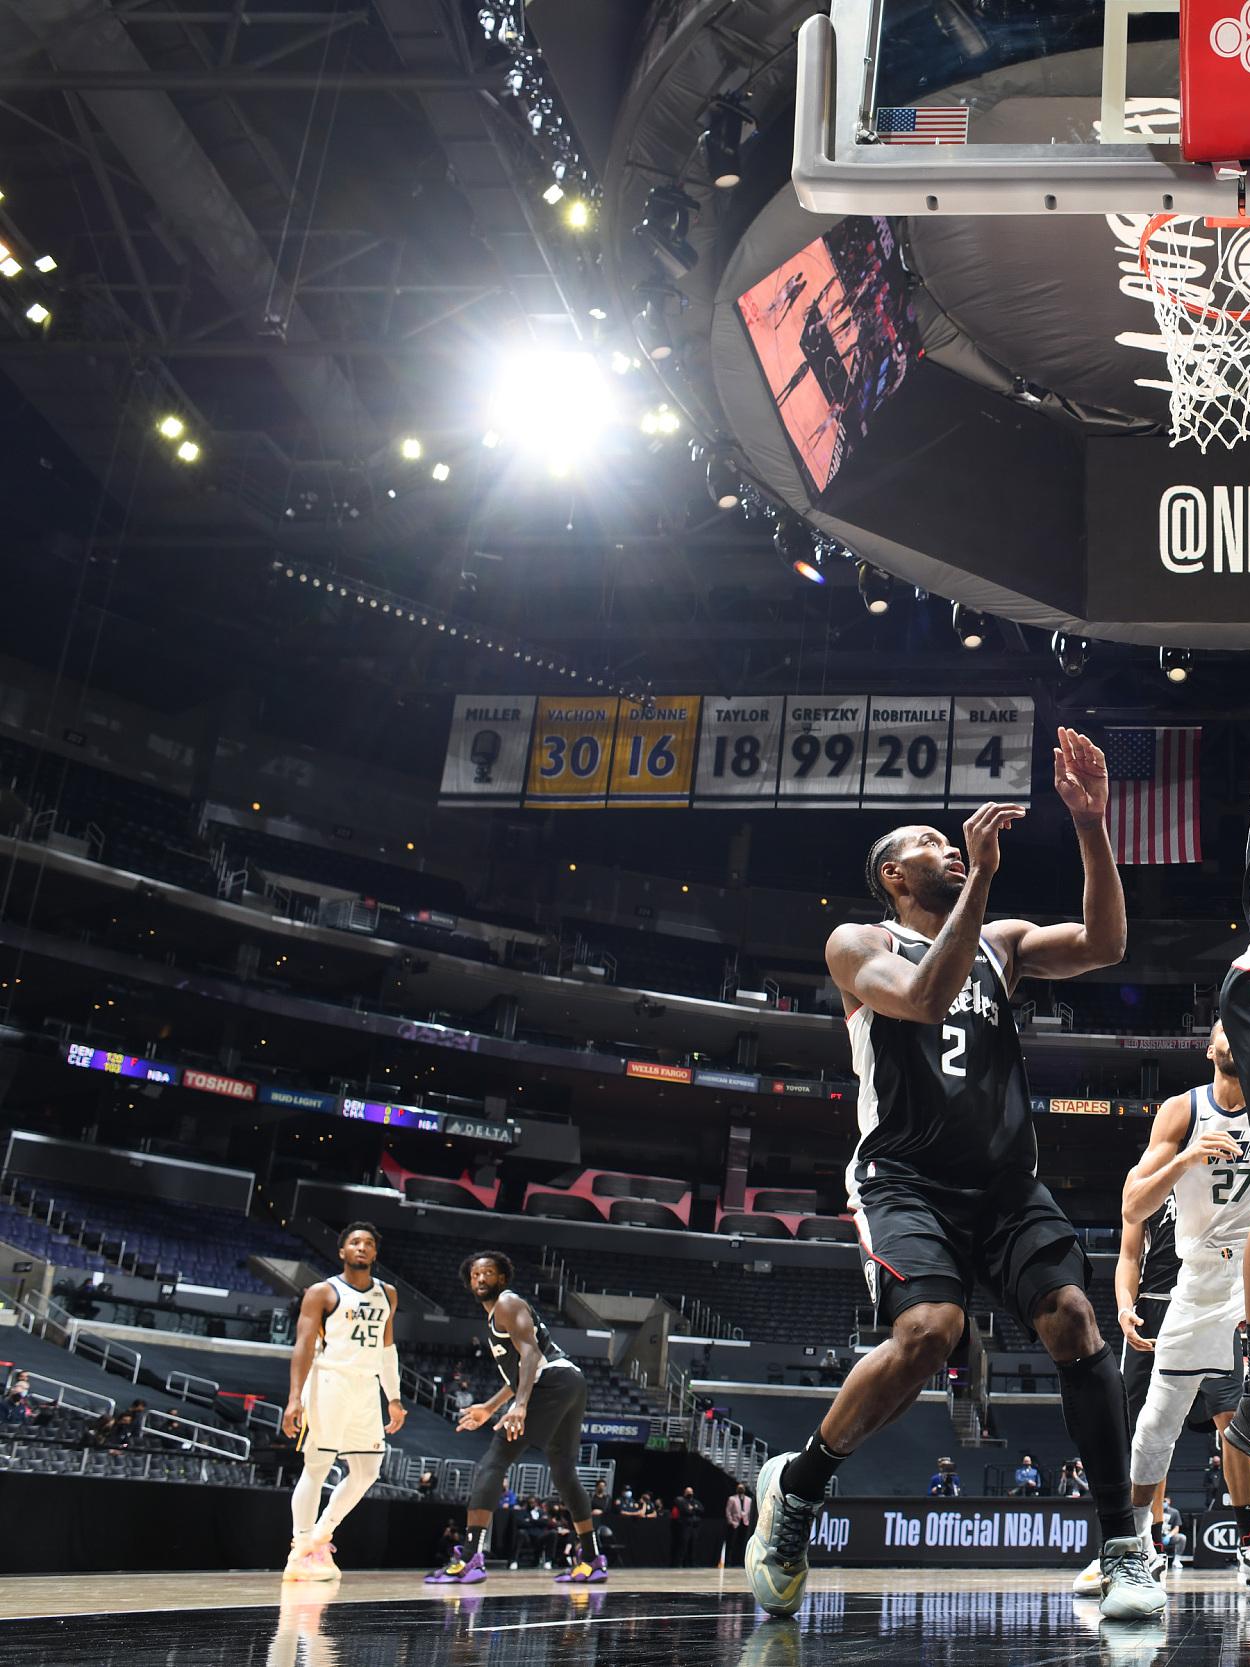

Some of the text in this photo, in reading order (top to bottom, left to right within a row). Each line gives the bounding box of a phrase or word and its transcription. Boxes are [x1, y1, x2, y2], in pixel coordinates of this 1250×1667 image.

[465, 708, 521, 722] MILLER
[547, 710, 607, 722] VACHON
[629, 708, 687, 721] DIONNE
[716, 709, 769, 722] TAYLOR
[792, 708, 859, 722] GRETZKY
[872, 709, 947, 723] ROBITAILLE
[969, 710, 1018, 723] BLAKE
[539, 735, 600, 778] 30
[627, 734, 676, 778] 16
[713, 735, 761, 778] 18
[791, 734, 855, 778] 99
[874, 735, 938, 779] 20
[975, 735, 1004, 779] 4
[69, 1043, 95, 1057] DEN
[942, 1024, 966, 1077] 2
[67, 1054, 91, 1068] CLE
[147, 1069, 170, 1083] NBA
[631, 1064, 688, 1079] WELLS FARGO
[185, 1071, 255, 1098] TOSHIBA
[698, 1075, 755, 1088] AMERICAN EXPRESS
[786, 1085, 810, 1093] TOYOTA
[271, 1092, 323, 1109] BUD LIGHT
[1051, 1099, 1108, 1114] STAPLES
[418, 1119, 439, 1131] NBA
[465, 1123, 509, 1139] DELTA
[351, 1324, 379, 1348] 45
[590, 1424, 639, 1436] EXPRESS
[818, 1512, 850, 1551] App
[884, 1511, 1088, 1553] The Official NBA App
